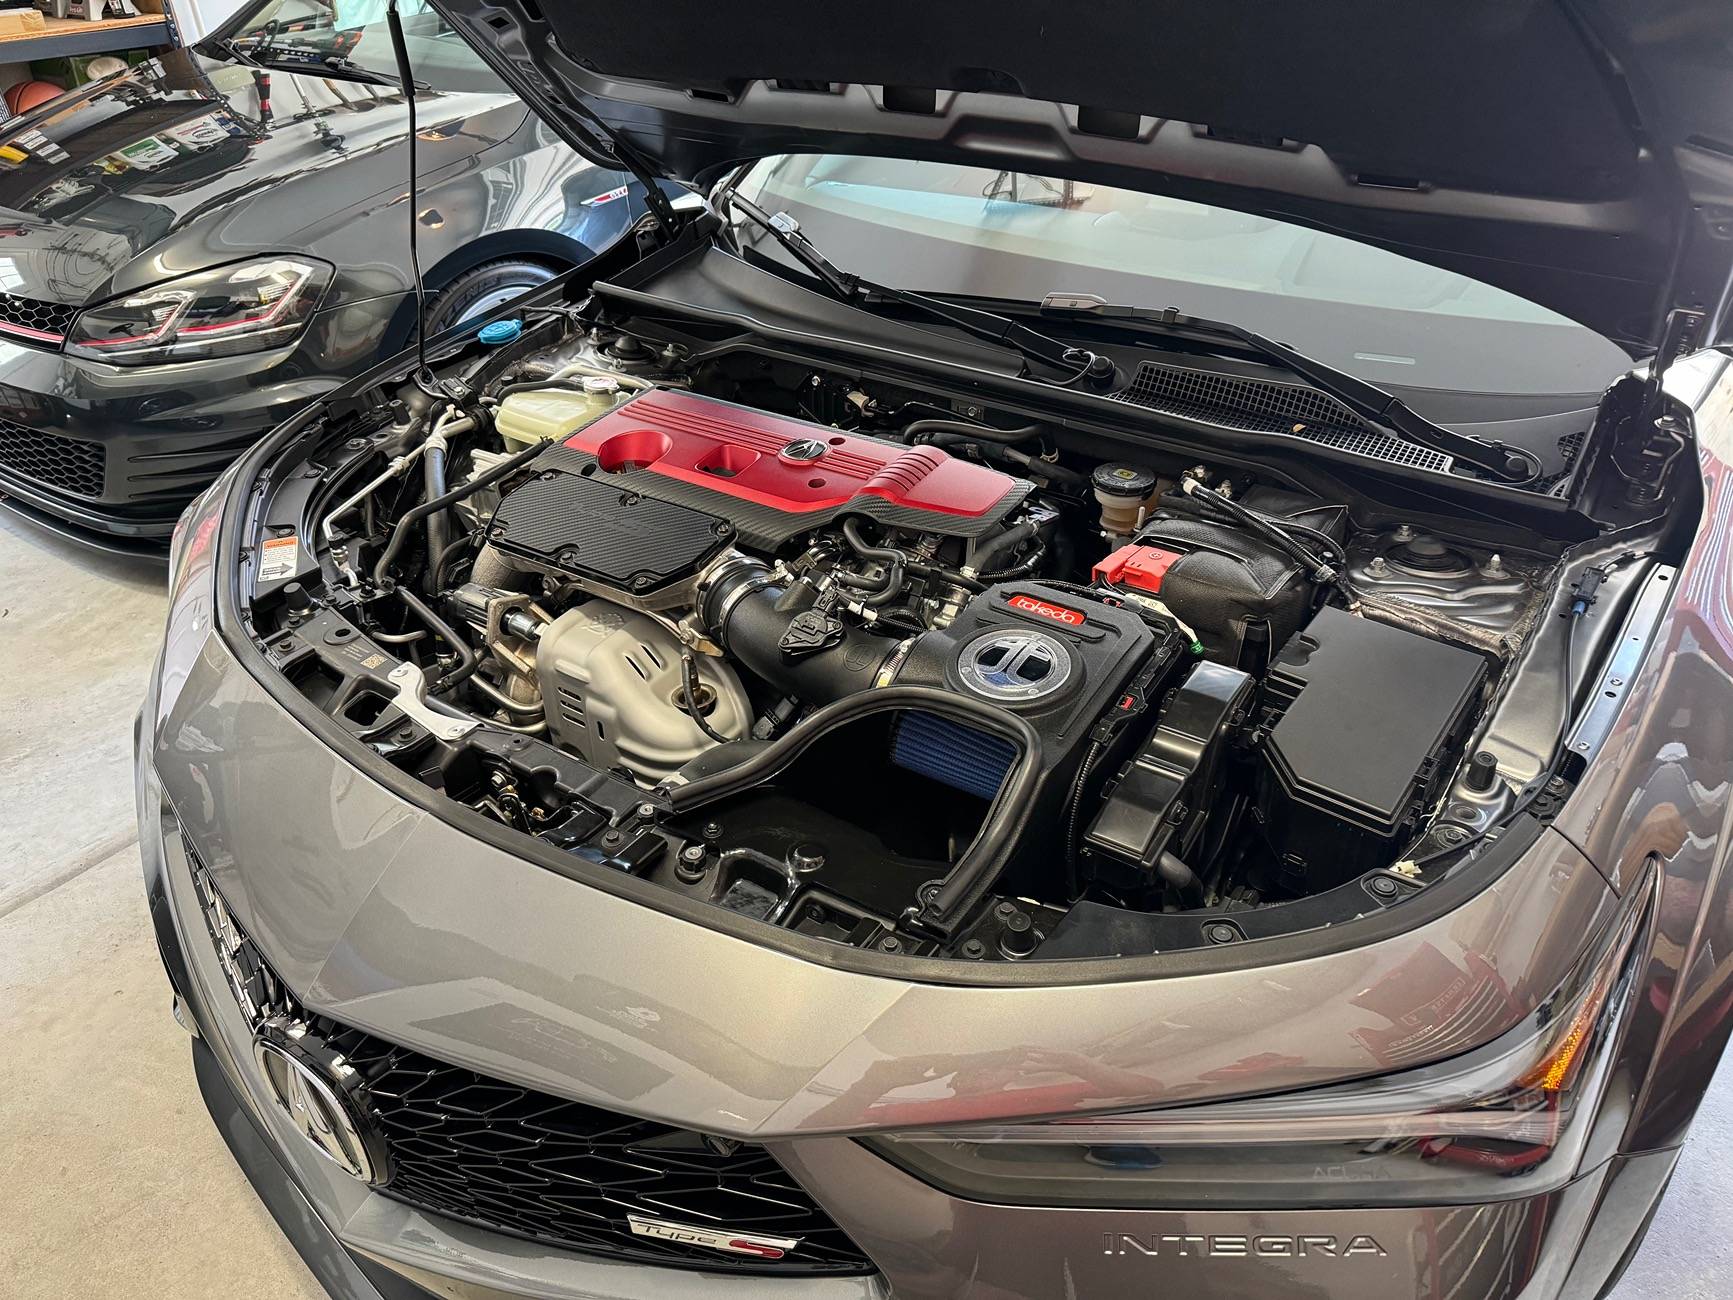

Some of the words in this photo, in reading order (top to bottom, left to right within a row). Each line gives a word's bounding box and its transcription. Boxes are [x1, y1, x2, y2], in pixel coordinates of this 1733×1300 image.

[1016, 598, 1075, 622] takeda
[728, 1239, 785, 1259] S
[1103, 1232, 1388, 1257] INTEGRA
